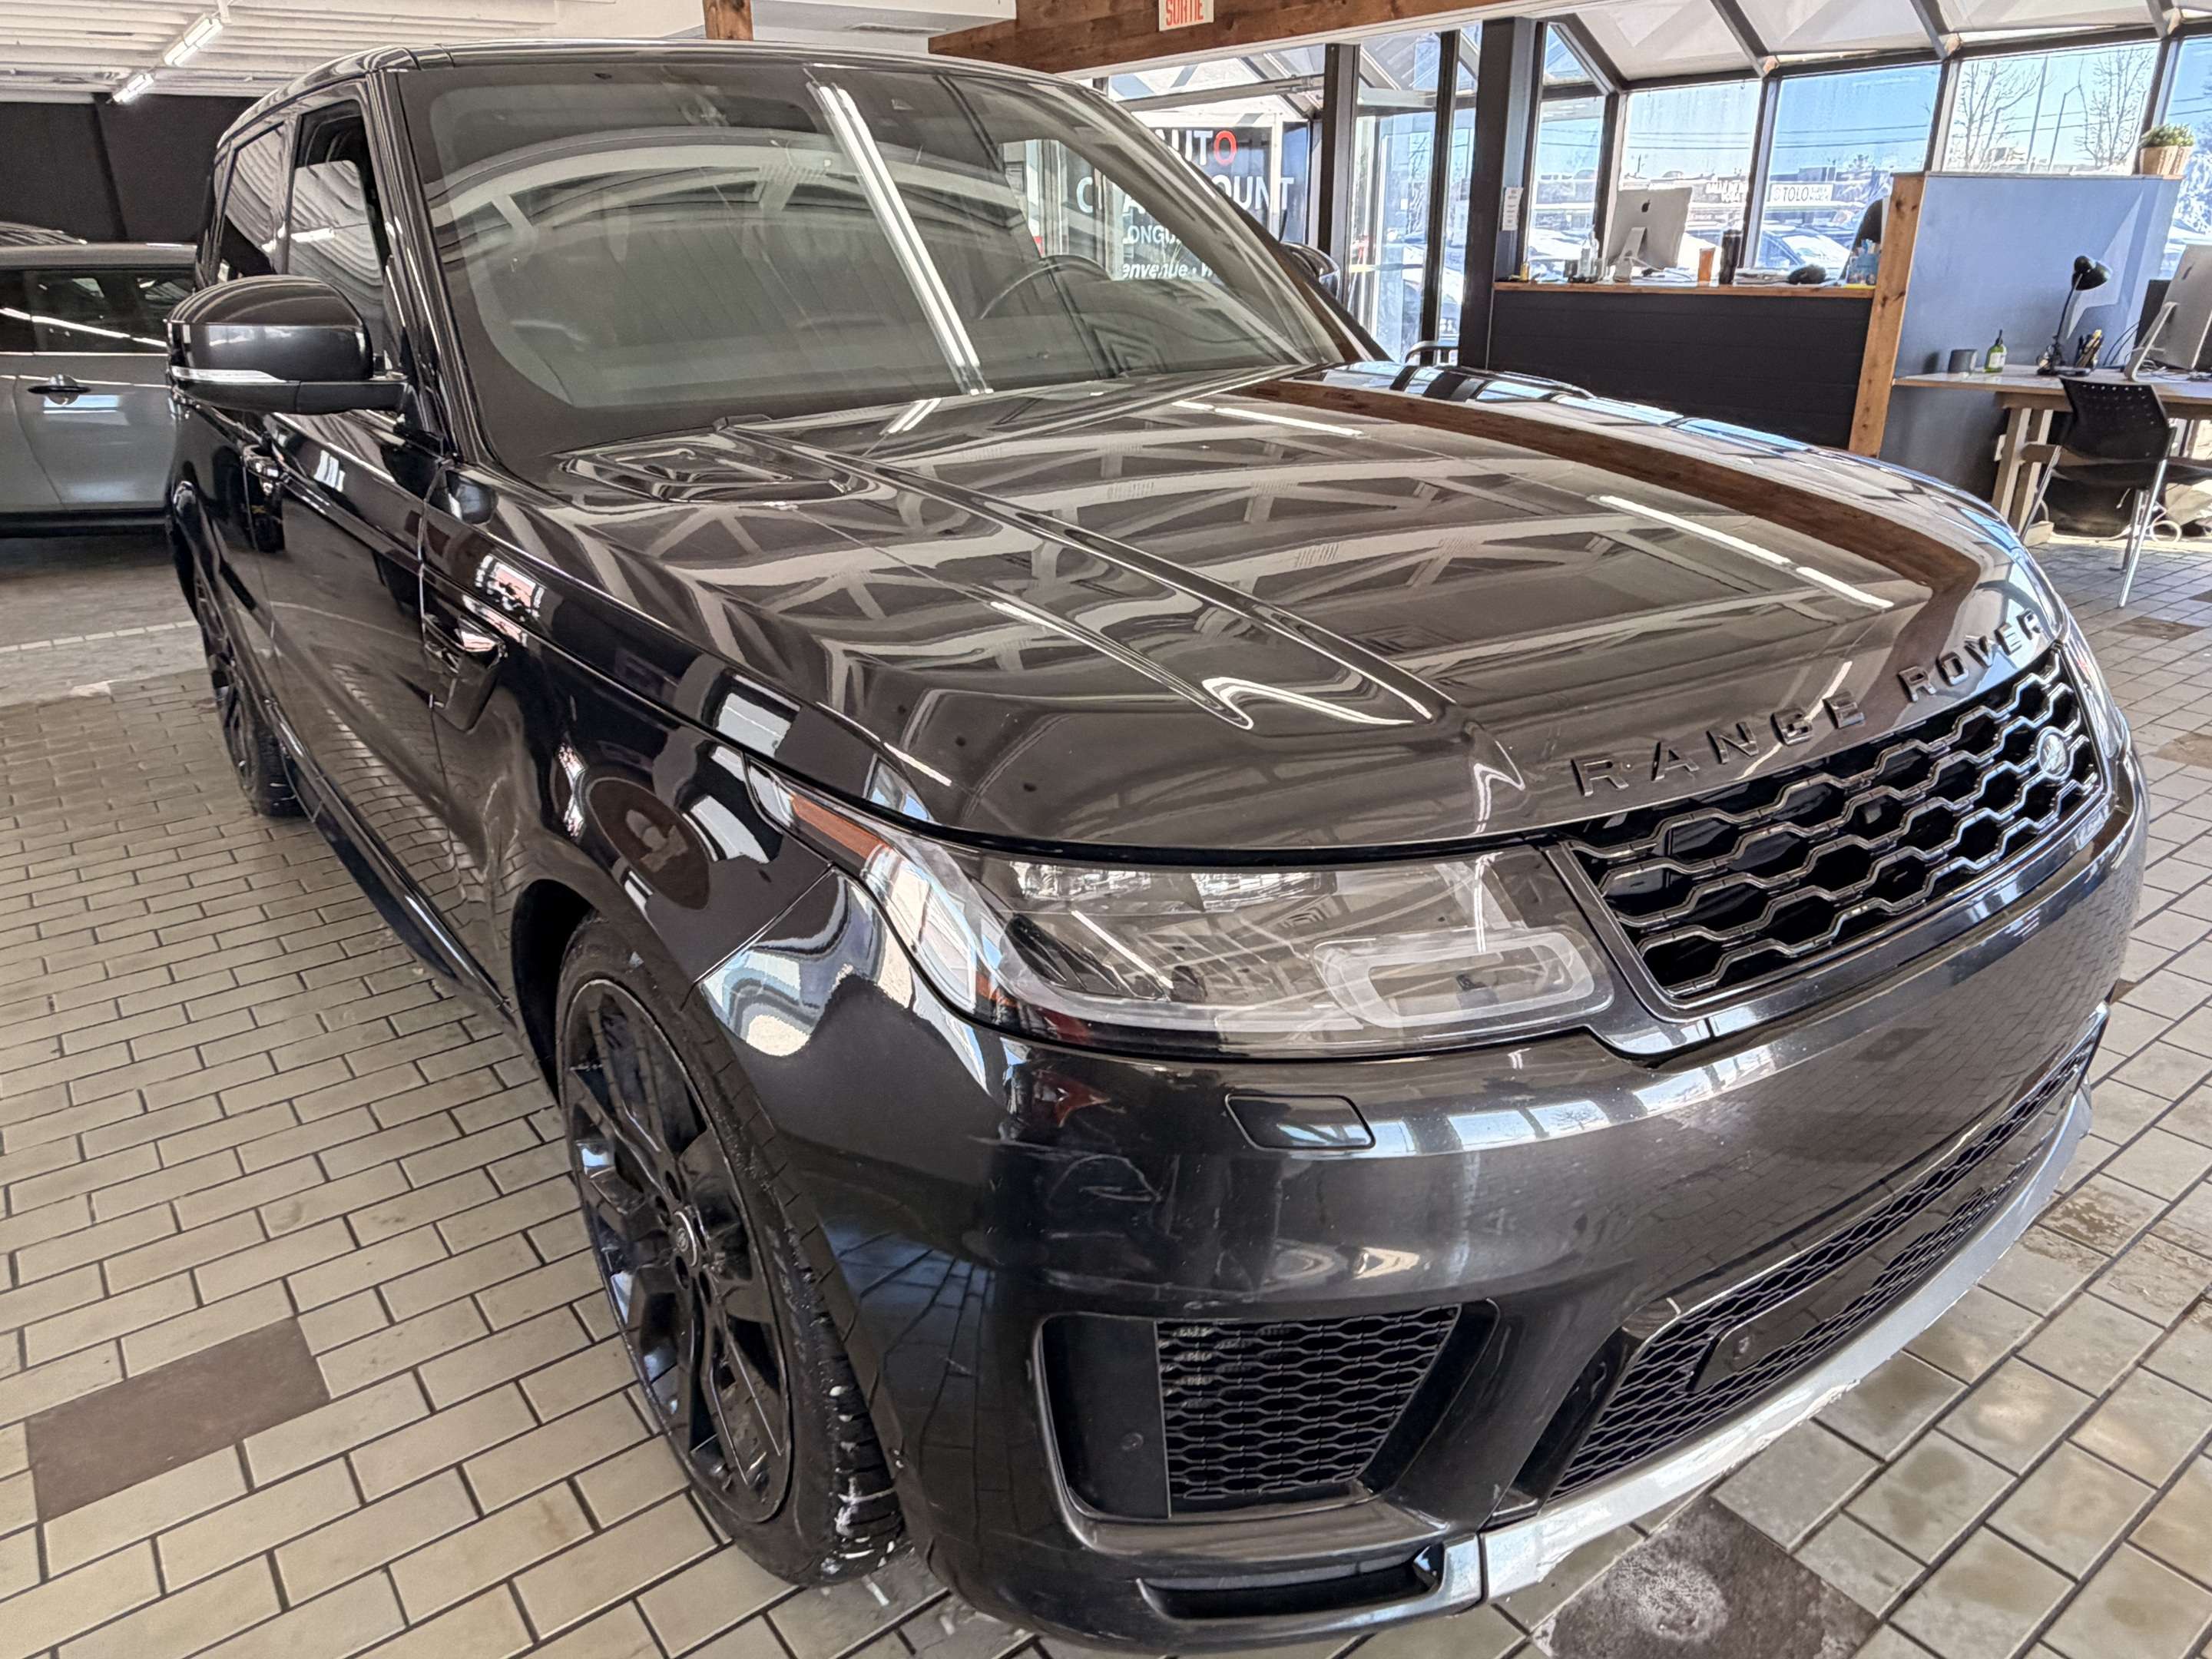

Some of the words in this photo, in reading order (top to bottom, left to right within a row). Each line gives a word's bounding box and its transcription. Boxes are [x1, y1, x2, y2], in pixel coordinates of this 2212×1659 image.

[1166, 0, 1204, 25] SORTIE
[1154, 129, 1237, 166] UTO
[1571, 690, 1866, 797] RANGE
[1896, 608, 2043, 702] ROVER
